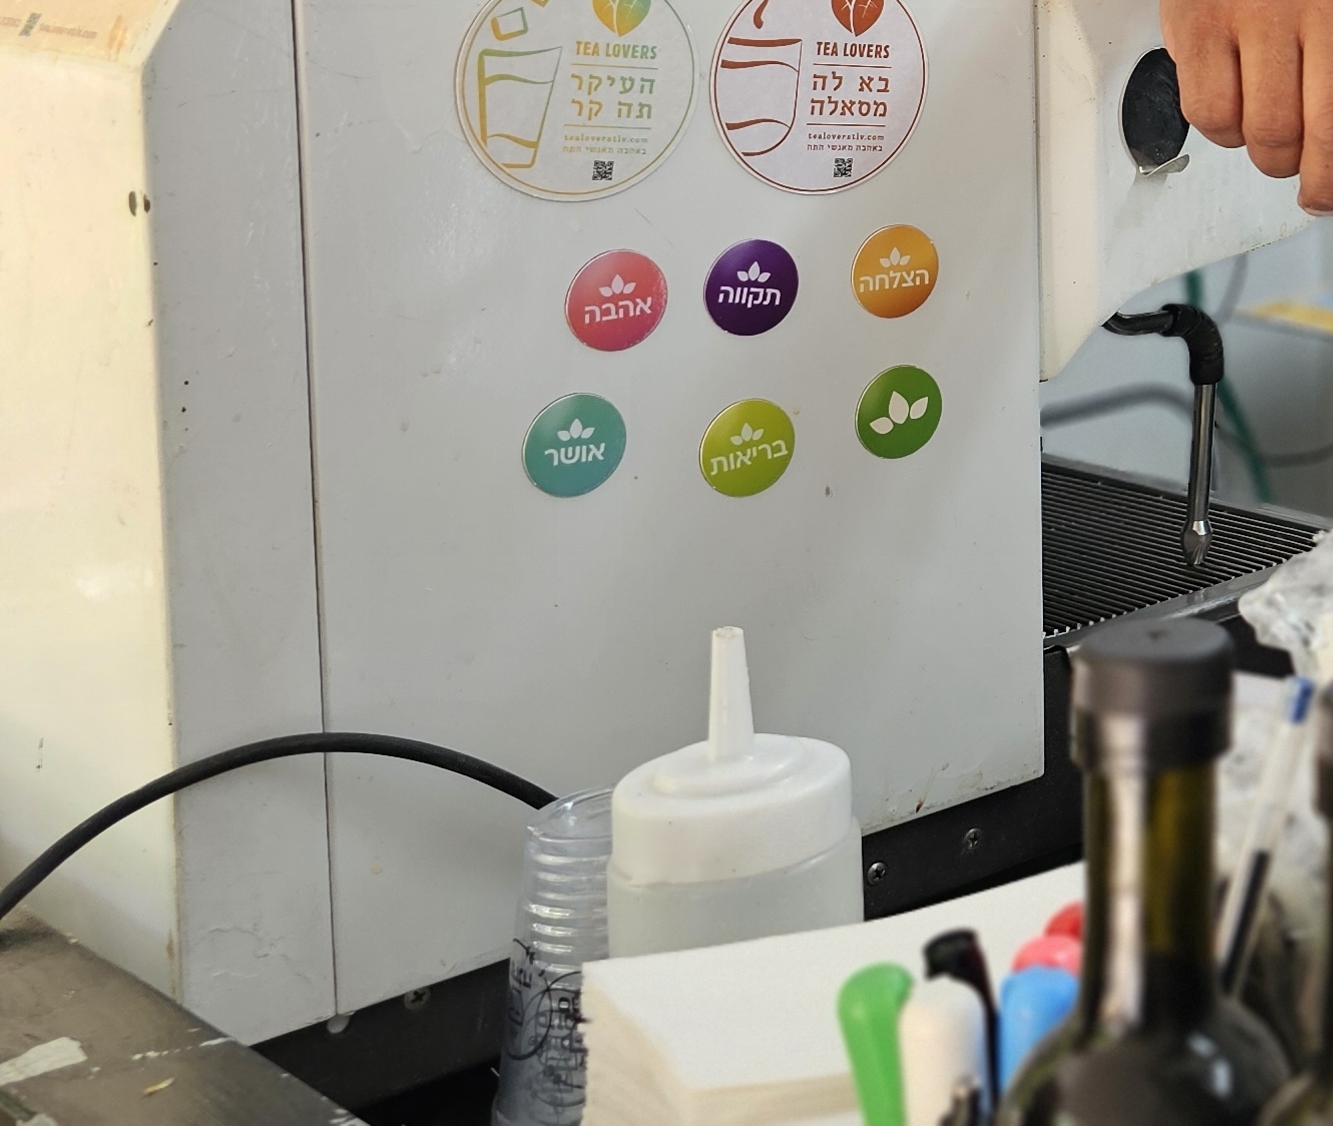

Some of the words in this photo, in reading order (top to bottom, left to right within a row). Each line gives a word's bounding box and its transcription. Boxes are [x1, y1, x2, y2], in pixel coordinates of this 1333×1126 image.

[576, 40, 600, 57] TEA
[605, 43, 658, 60] LOVERS
[817, 41, 839, 57] TEA
[843, 42, 890, 59] LOVERS
[570, 73, 656, 96] העיקר
[812, 71, 843, 91] לה
[858, 75, 890, 93] בא
[571, 98, 603, 121] קר
[617, 101, 652, 119] תה
[810, 96, 888, 117] מסאלה
[808, 132, 885, 141] tealoverstlv.com
[859, 268, 930, 292] הצלחה
[718, 286, 782, 308] תקווה
[584, 296, 652, 324] אהבה
[544, 442, 606, 467] אושר
[710, 439, 789, 476] בריאות
